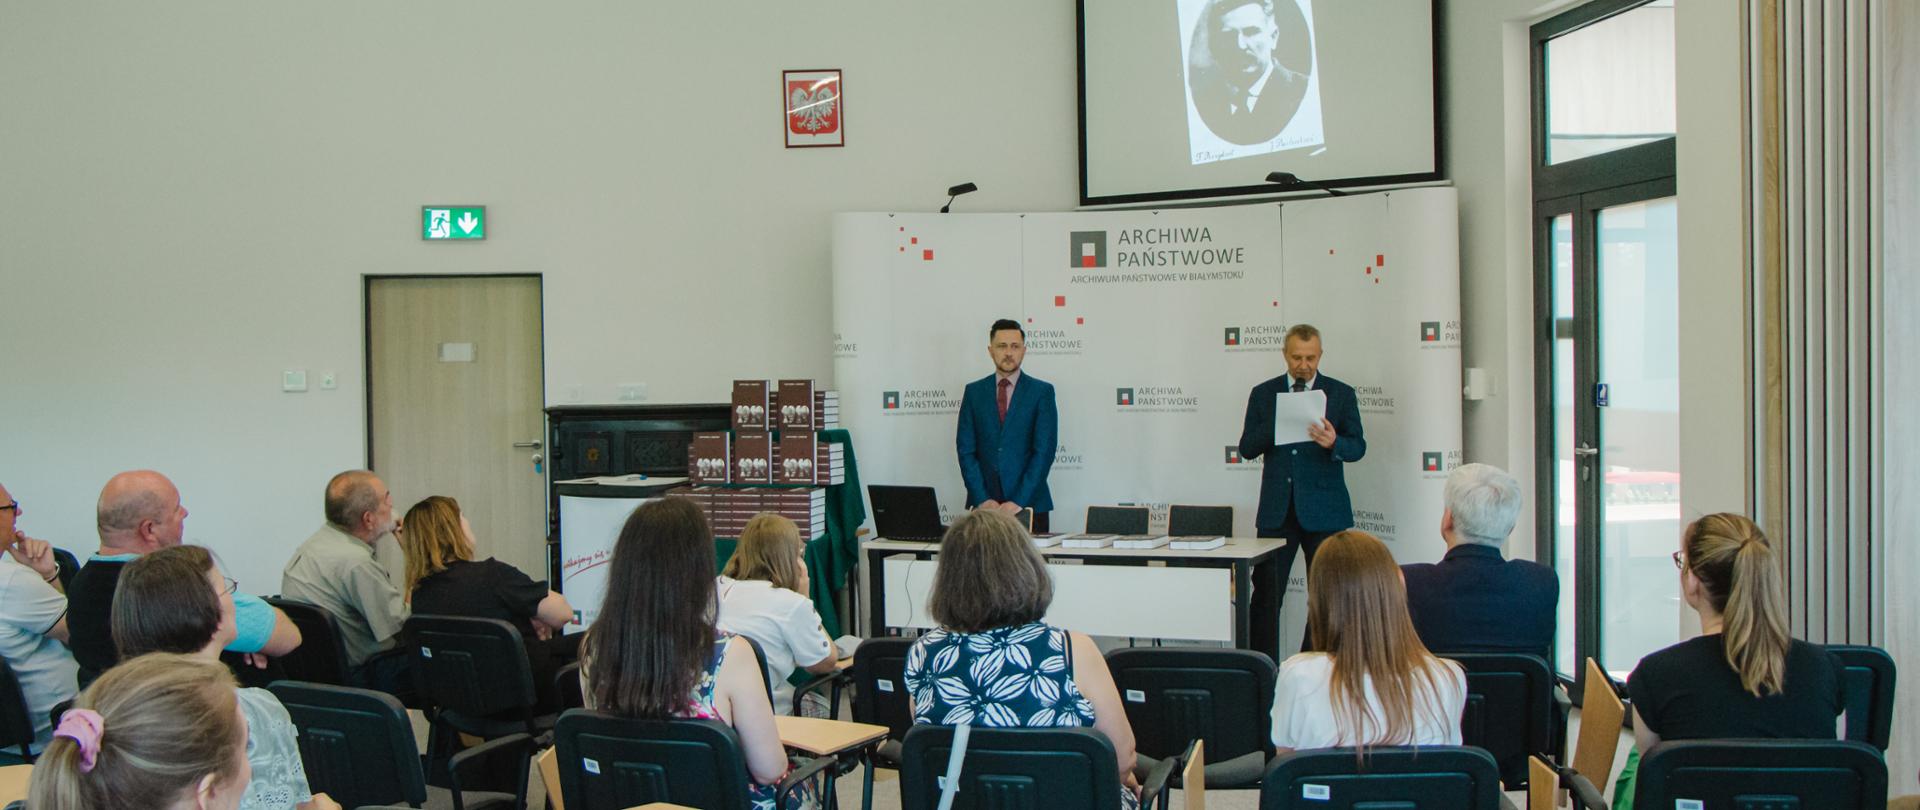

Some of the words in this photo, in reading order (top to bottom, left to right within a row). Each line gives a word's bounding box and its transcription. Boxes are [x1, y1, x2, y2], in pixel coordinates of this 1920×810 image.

[1118, 227, 1213, 245] ARCHIWA
[1117, 246, 1245, 268] PAŃSTWOWE
[1070, 273, 1120, 284] ARCHIWUM
[1121, 271, 1176, 283] PAŃSTWOWE
[1179, 273, 1188, 282] W
[1189, 271, 1244, 281] BIAŁYMSTOKU
[1027, 330, 1065, 338] RCHIWA
[903, 389, 946, 399] ARCHIWA
[1138, 387, 1183, 396] ARCHIWA
